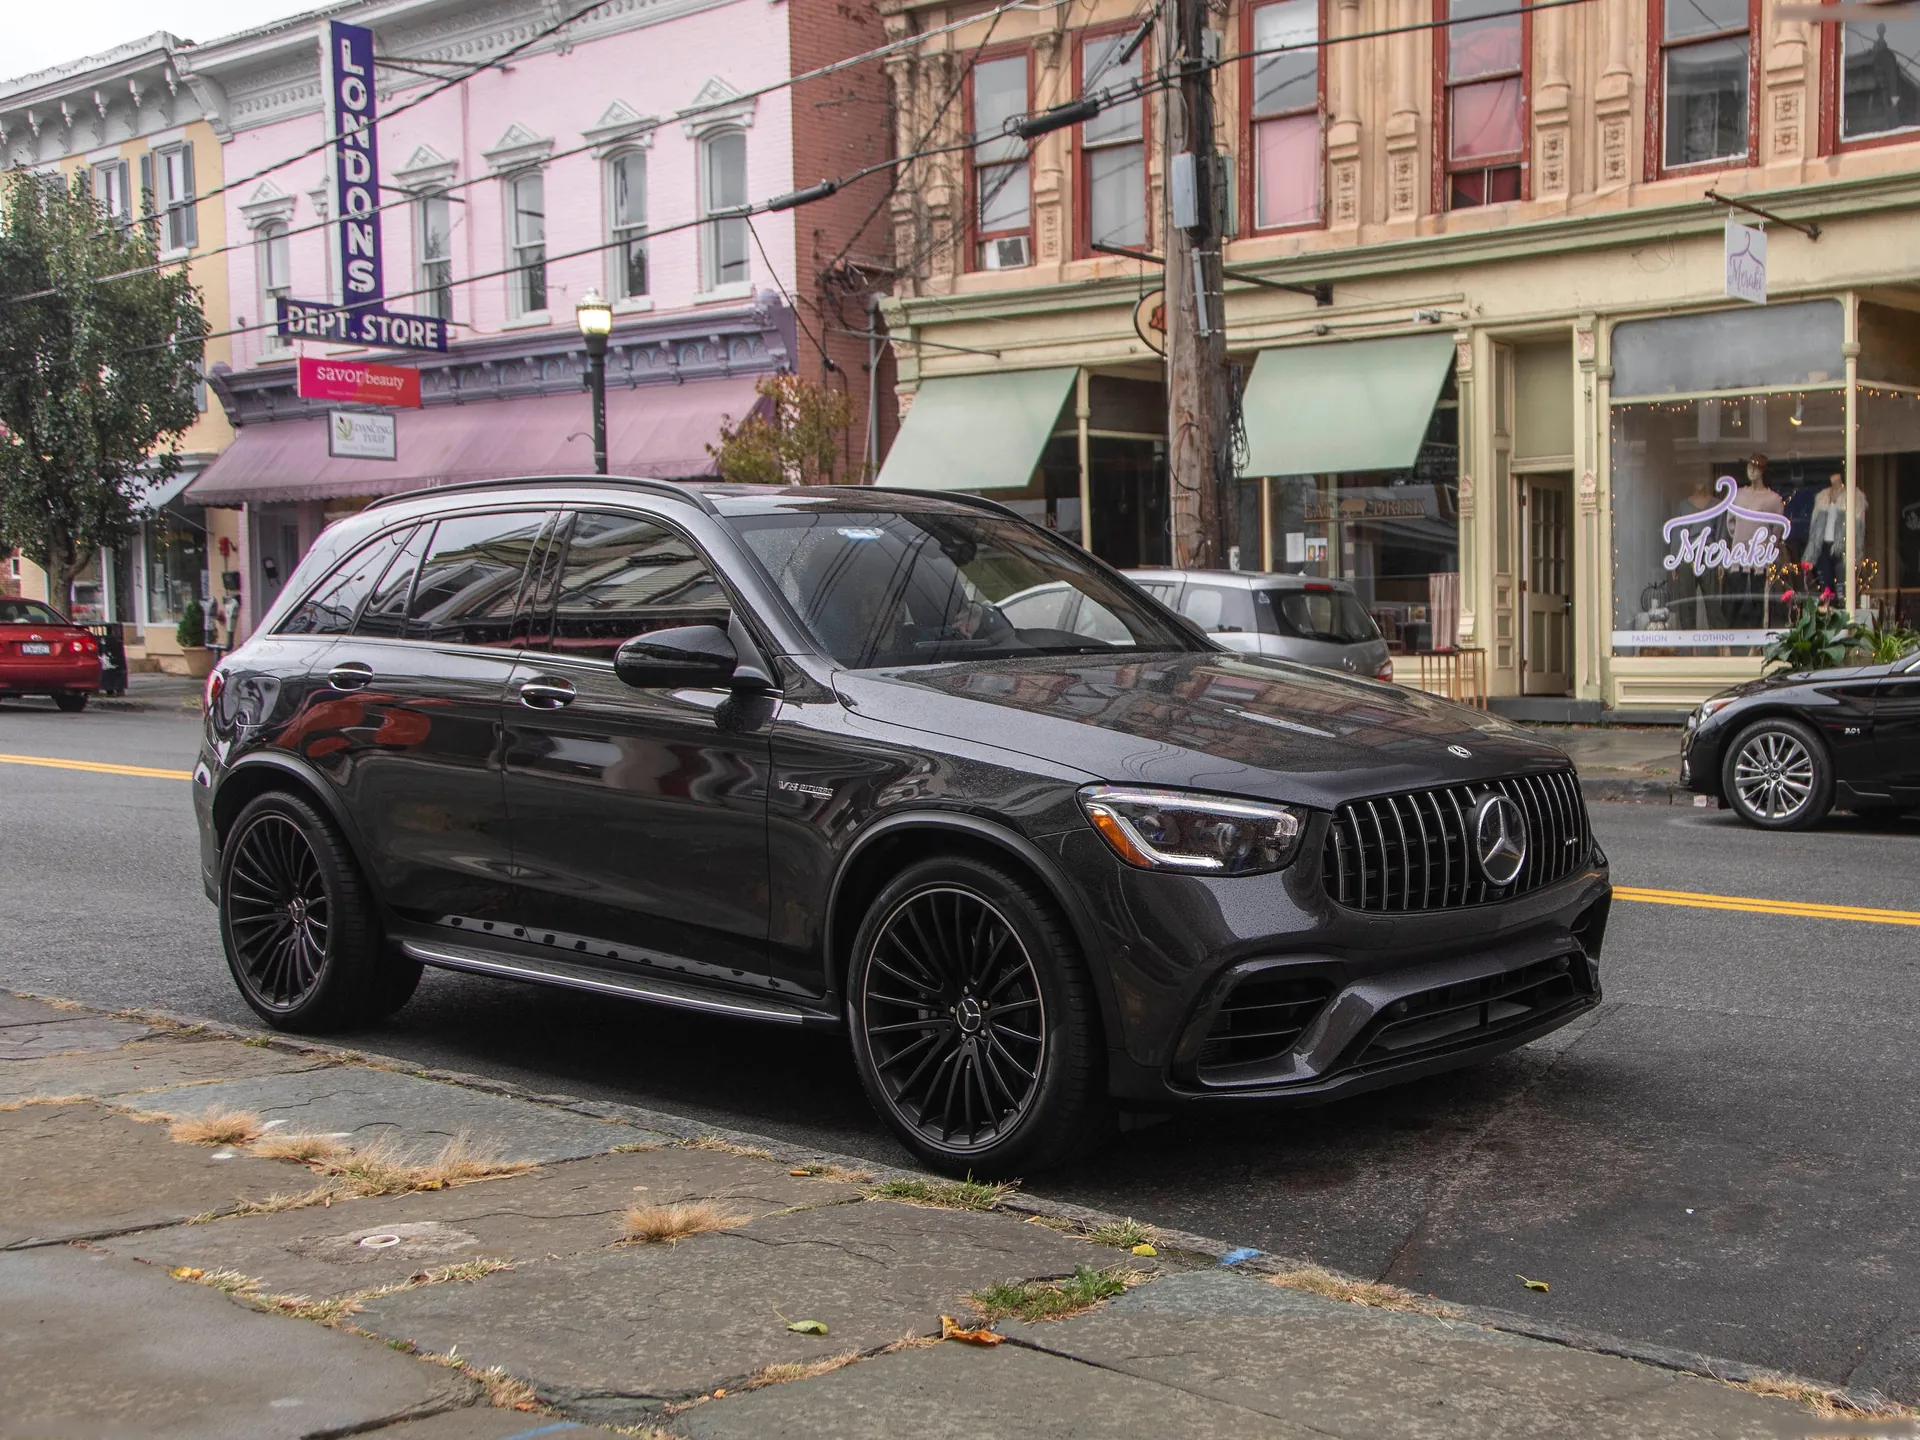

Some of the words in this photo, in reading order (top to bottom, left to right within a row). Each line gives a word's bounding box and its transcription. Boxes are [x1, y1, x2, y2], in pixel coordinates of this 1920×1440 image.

[340, 37, 376, 294] LONDONS
[1727, 258, 1764, 292] Meraki
[286, 305, 358, 340] DEPT.
[361, 313, 439, 349] STORE
[365, 371, 405, 391] beauty
[1303, 501, 1338, 519] EAT
[1373, 498, 1426, 516] DRINK
[1663, 526, 1780, 577] Meraki
[1631, 634, 1668, 643] FASHION
[1692, 633, 1735, 643] CLOTHING
[778, 780, 799, 792] V8
[799, 783, 834, 795] BITURBO
